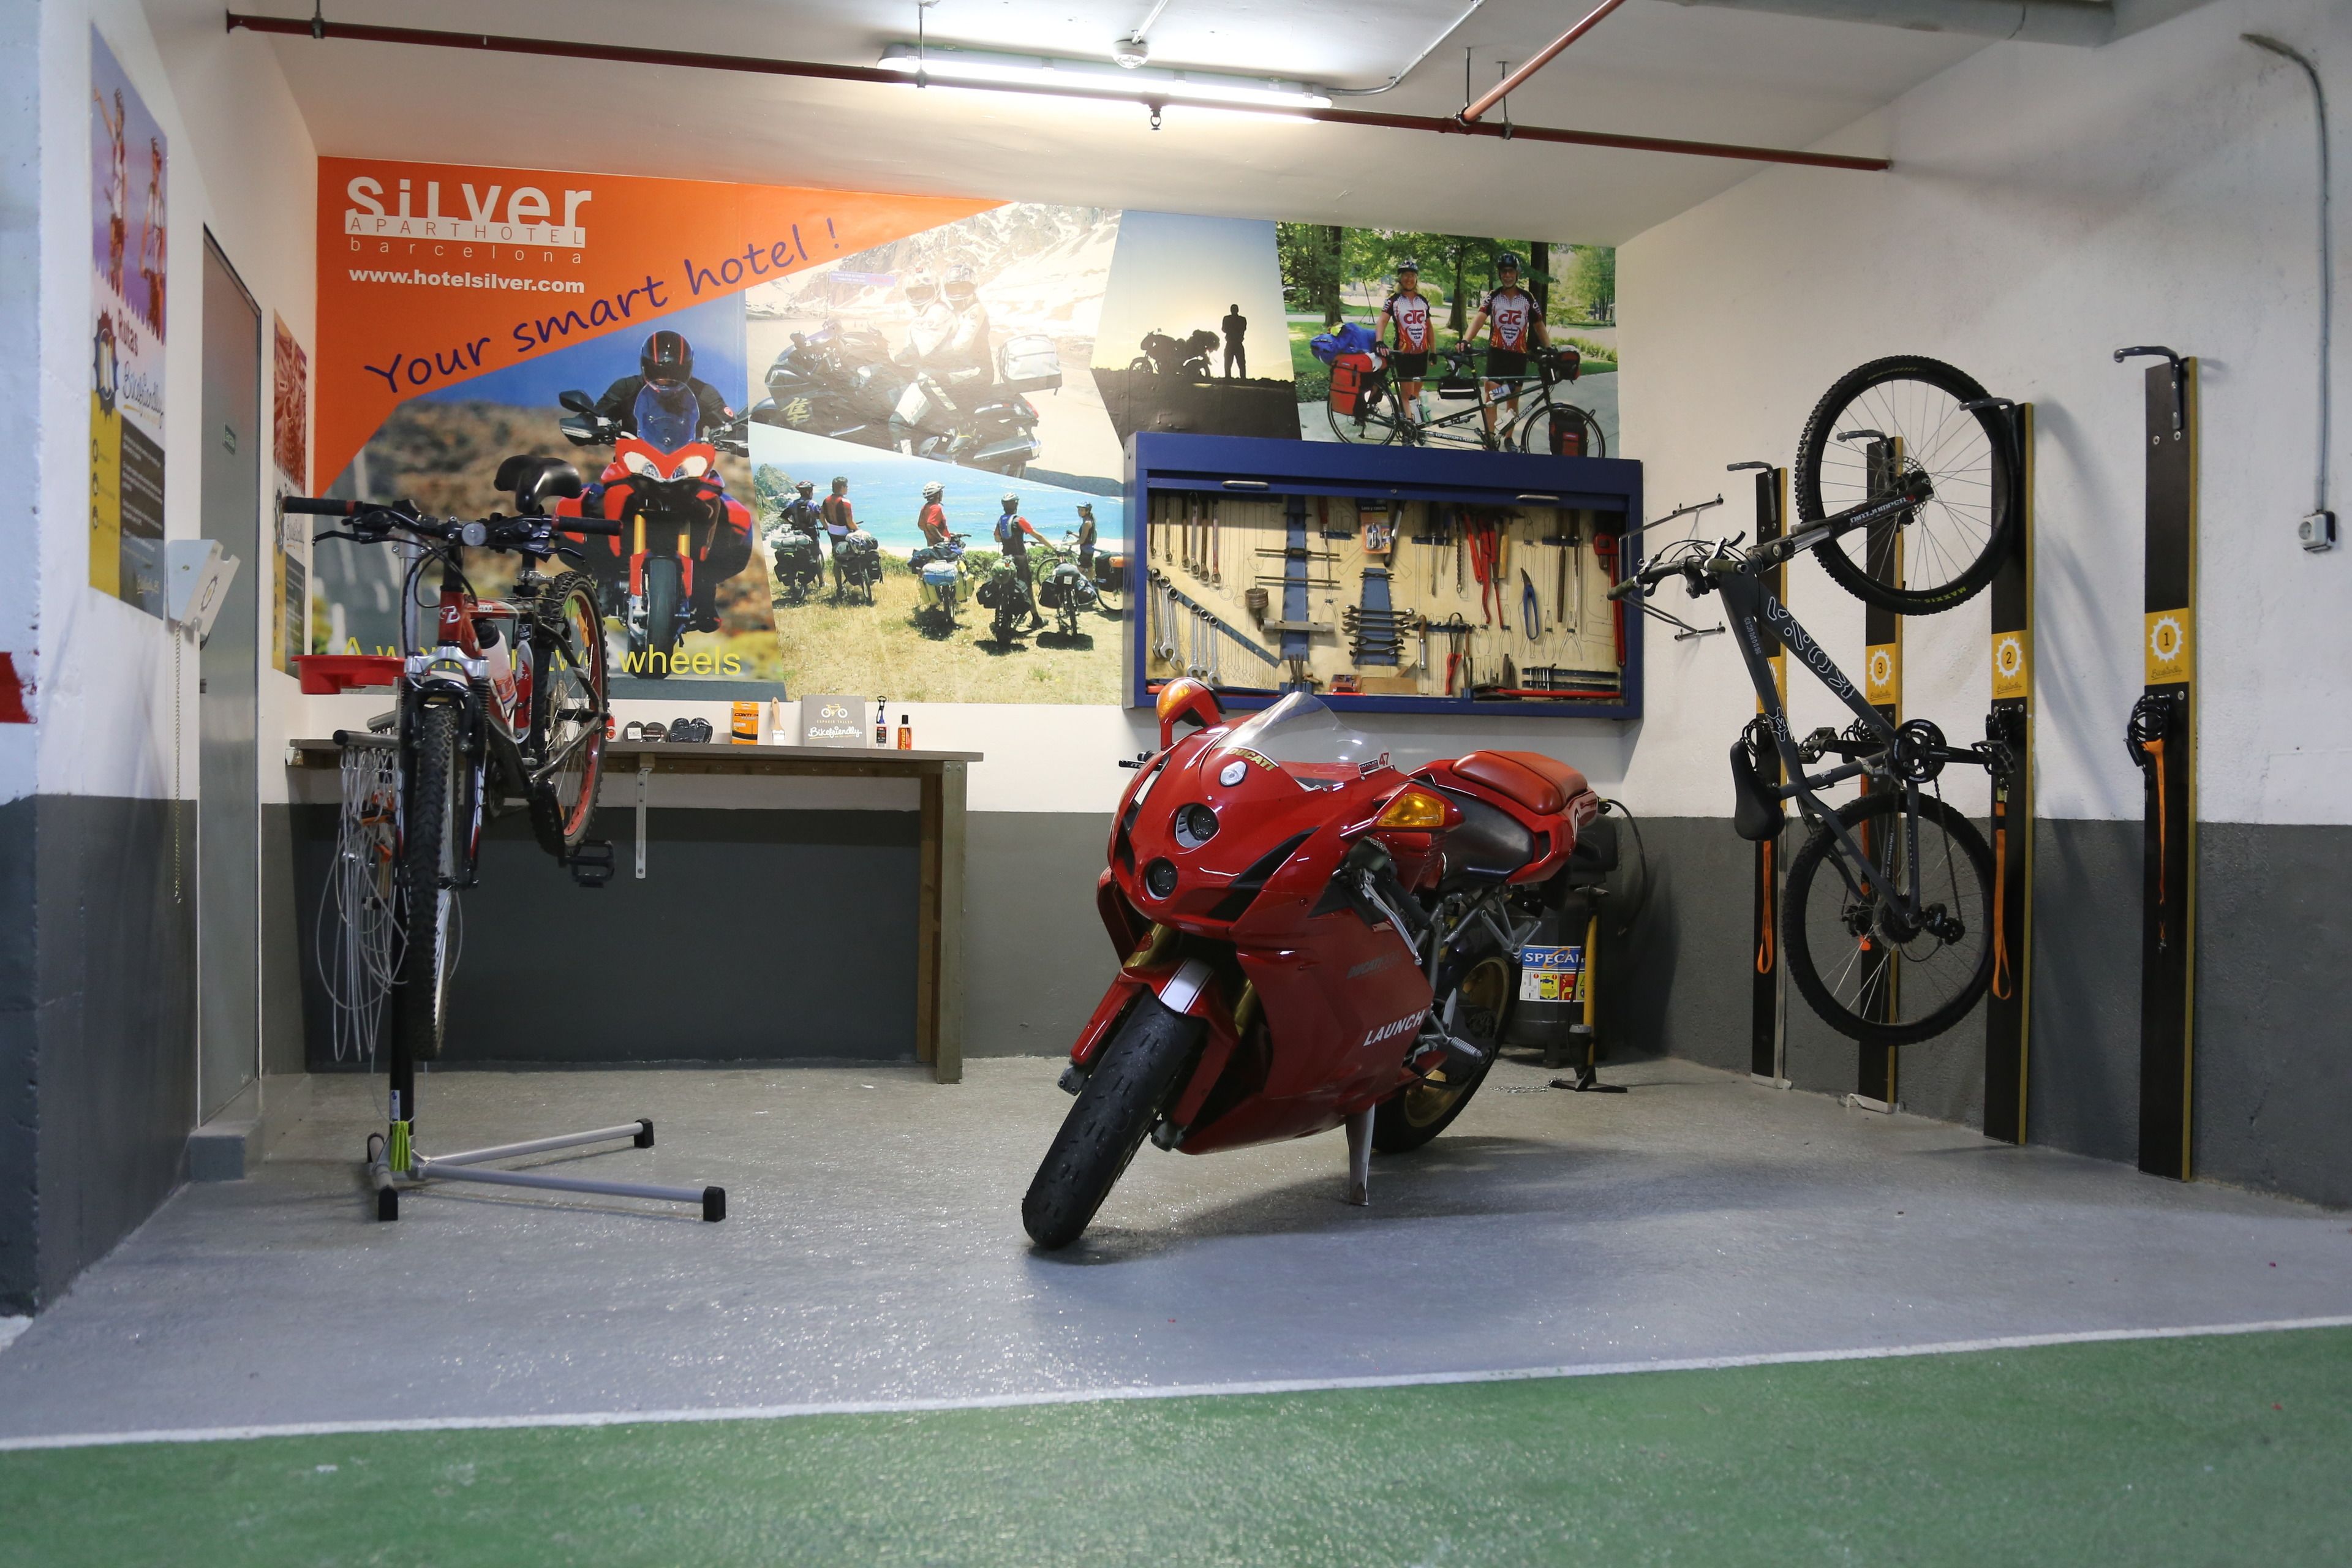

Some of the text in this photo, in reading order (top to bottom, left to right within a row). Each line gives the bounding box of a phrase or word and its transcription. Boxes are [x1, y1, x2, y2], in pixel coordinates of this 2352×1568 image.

[350, 216, 583, 246] APARTHOTEL
[350, 236, 581, 265] barcelona
[349, 270, 585, 293] www.hotelsilver.com
[364, 337, 491, 394] Your
[513, 275, 668, 352] smart
[684, 224, 809, 295] hotel
[1924, 586, 1967, 603] MAXXIS
[2164, 632, 2169, 646] 1
[620, 645, 741, 675] wheels
[1878, 662, 1883, 674] 3
[2006, 651, 2012, 664] 2
[809, 726, 862, 739] Bikefriendly
[1228, 748, 1275, 771] DUCATI
[1379, 752, 1389, 765] 47
[1363, 1009, 1426, 1046] LAUNCH
